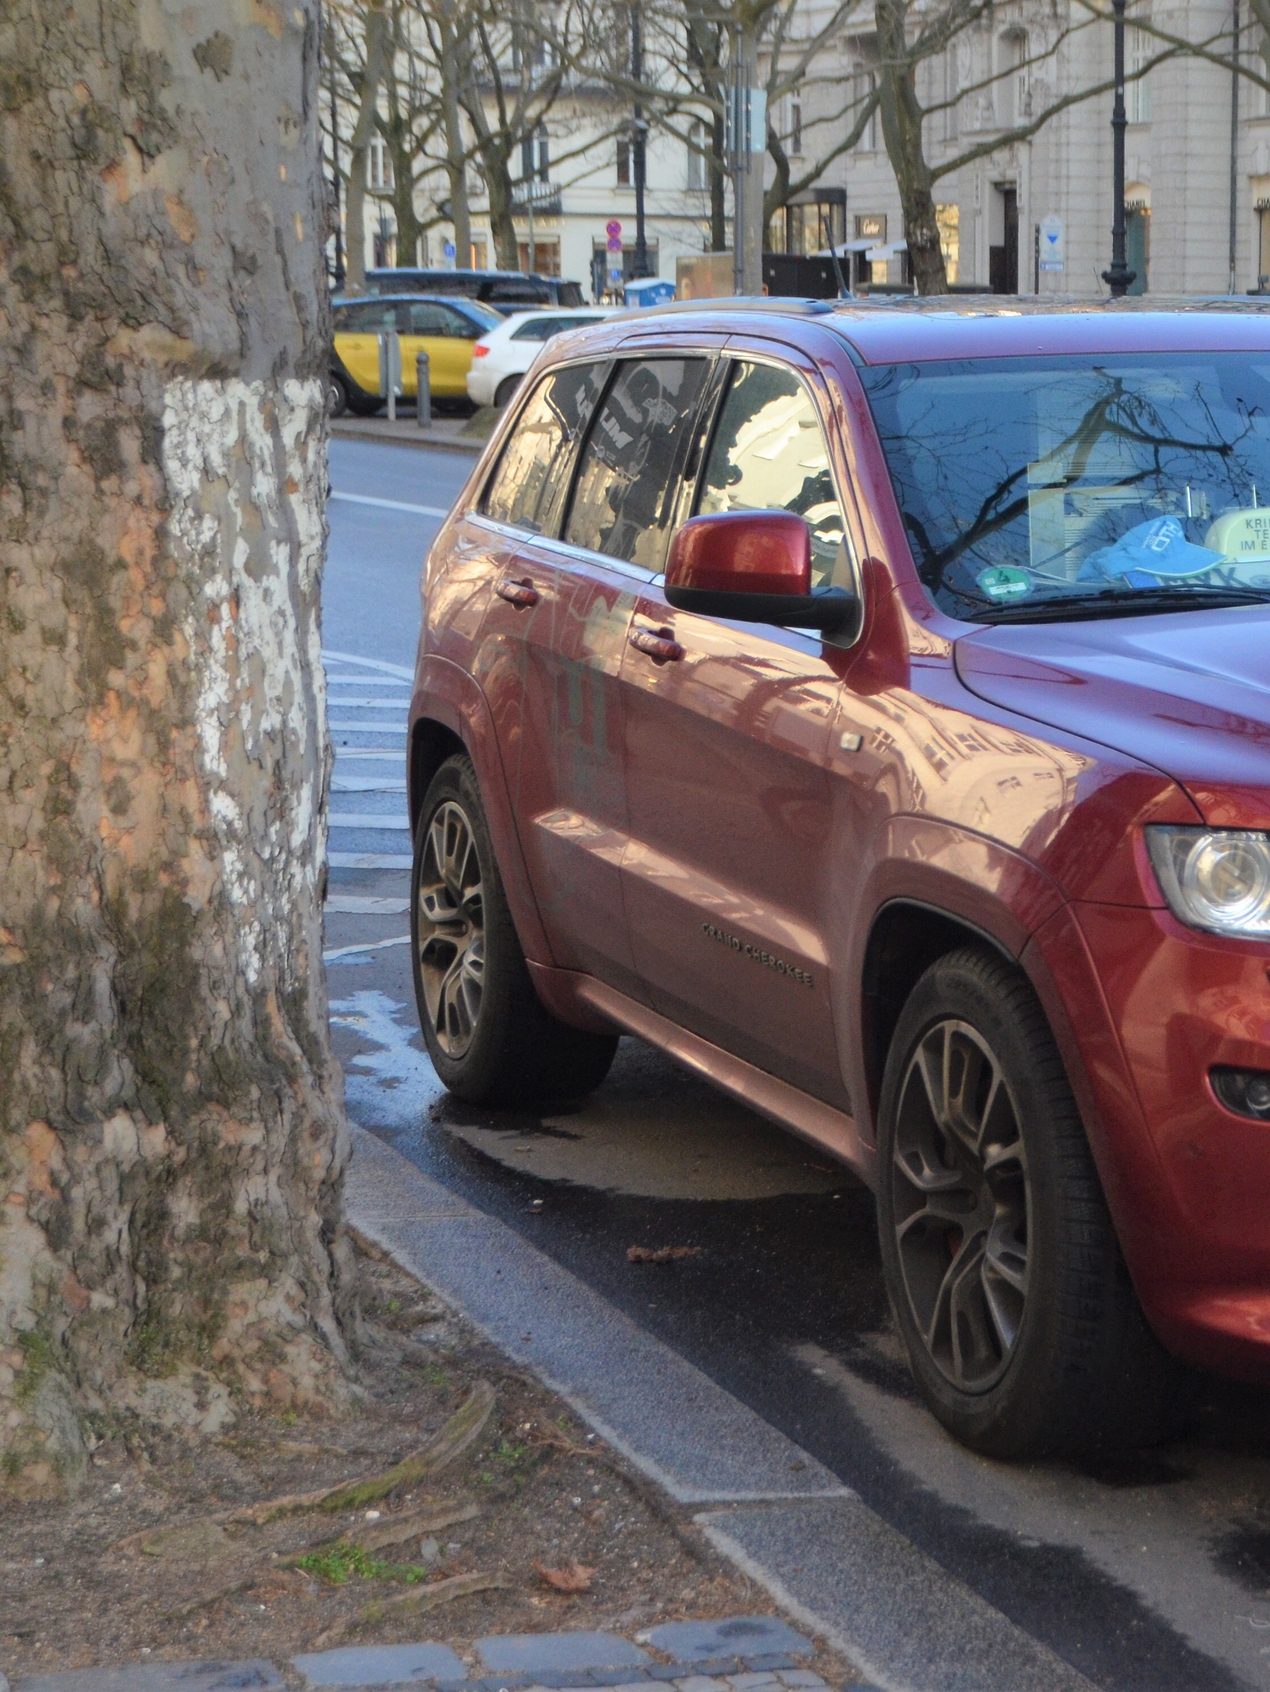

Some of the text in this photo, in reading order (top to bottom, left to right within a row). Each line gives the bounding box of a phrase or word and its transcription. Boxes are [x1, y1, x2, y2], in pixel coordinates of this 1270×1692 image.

[1241, 541, 1256, 550] IM
[702, 922, 814, 988] GRAND CHEROKEE
